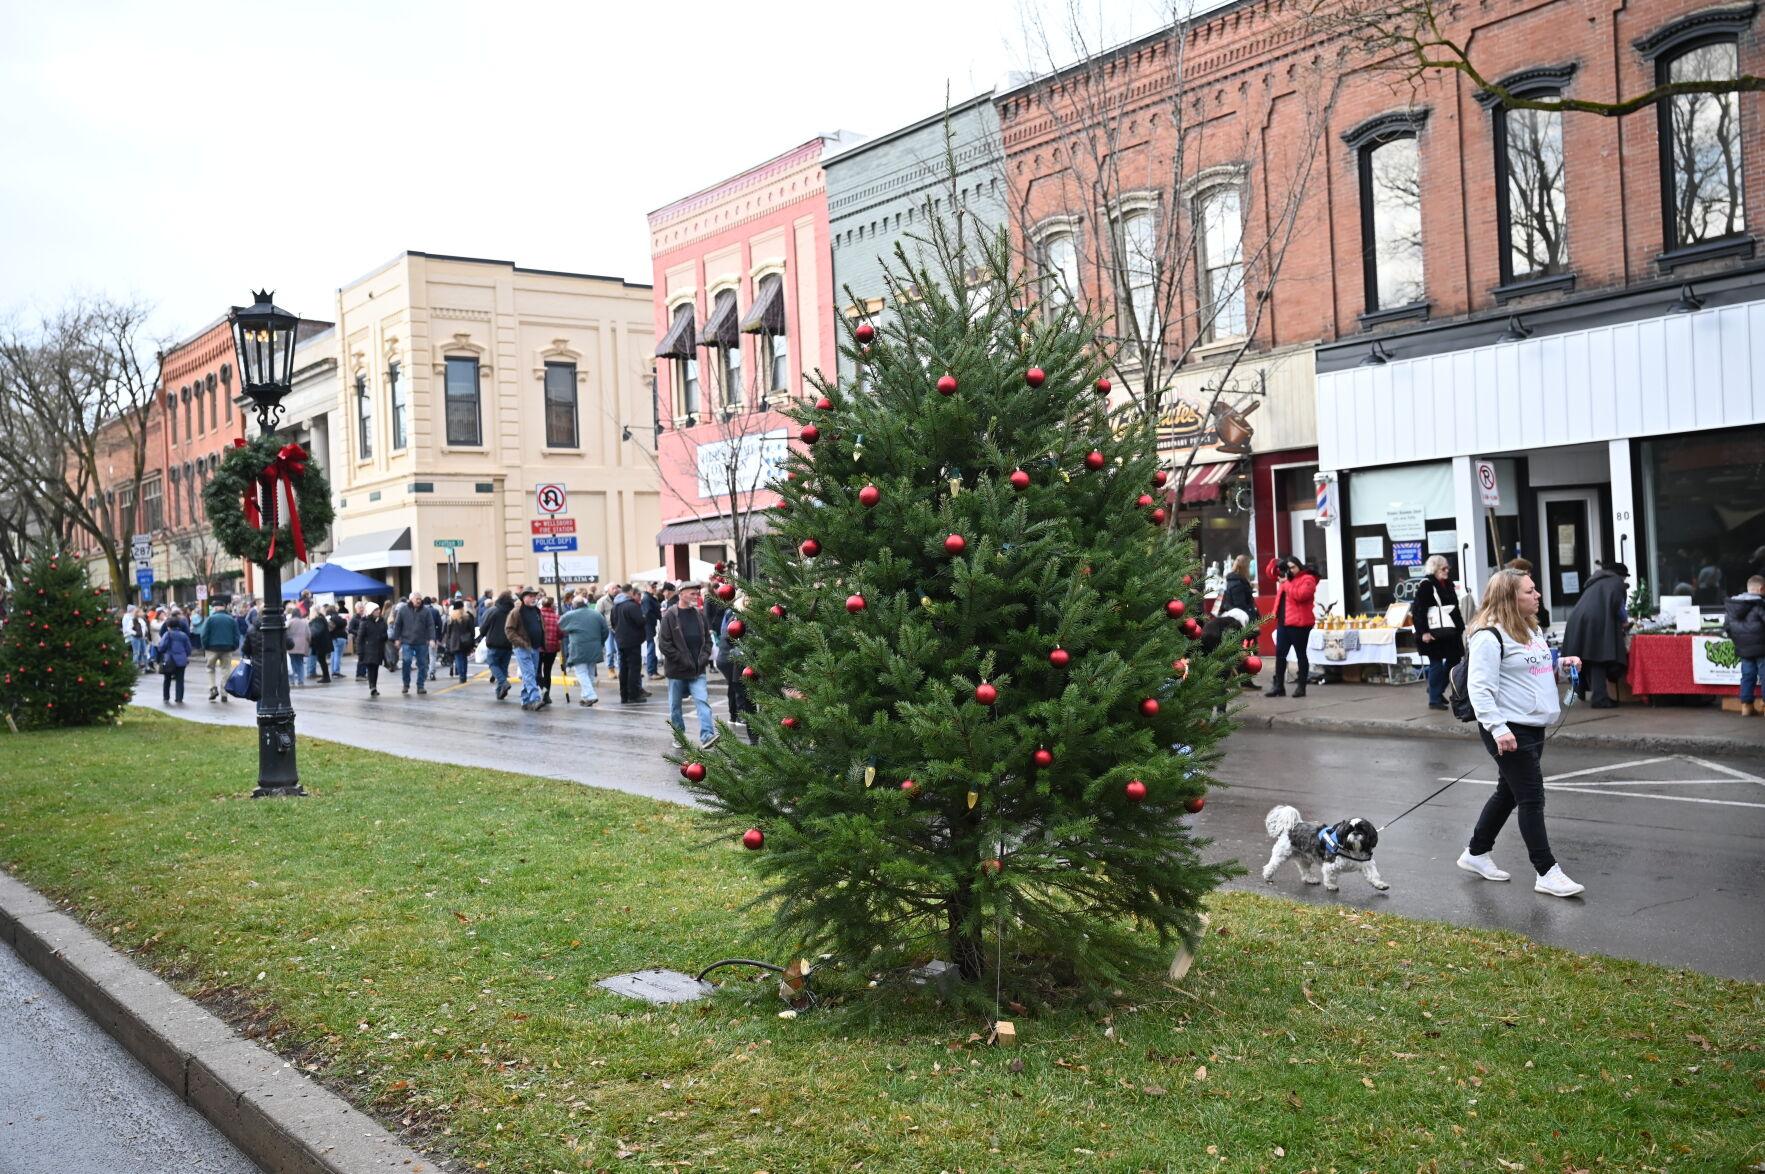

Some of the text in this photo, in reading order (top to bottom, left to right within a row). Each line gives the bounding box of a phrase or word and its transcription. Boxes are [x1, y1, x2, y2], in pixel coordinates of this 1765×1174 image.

[1616, 511, 1630, 521] 80
[543, 519, 573, 527] WELLSBORO
[535, 537, 572, 546] POLICE DEPT
[134, 545, 151, 556] 287
[544, 576, 552, 584] 24
[573, 575, 588, 583] ATM
